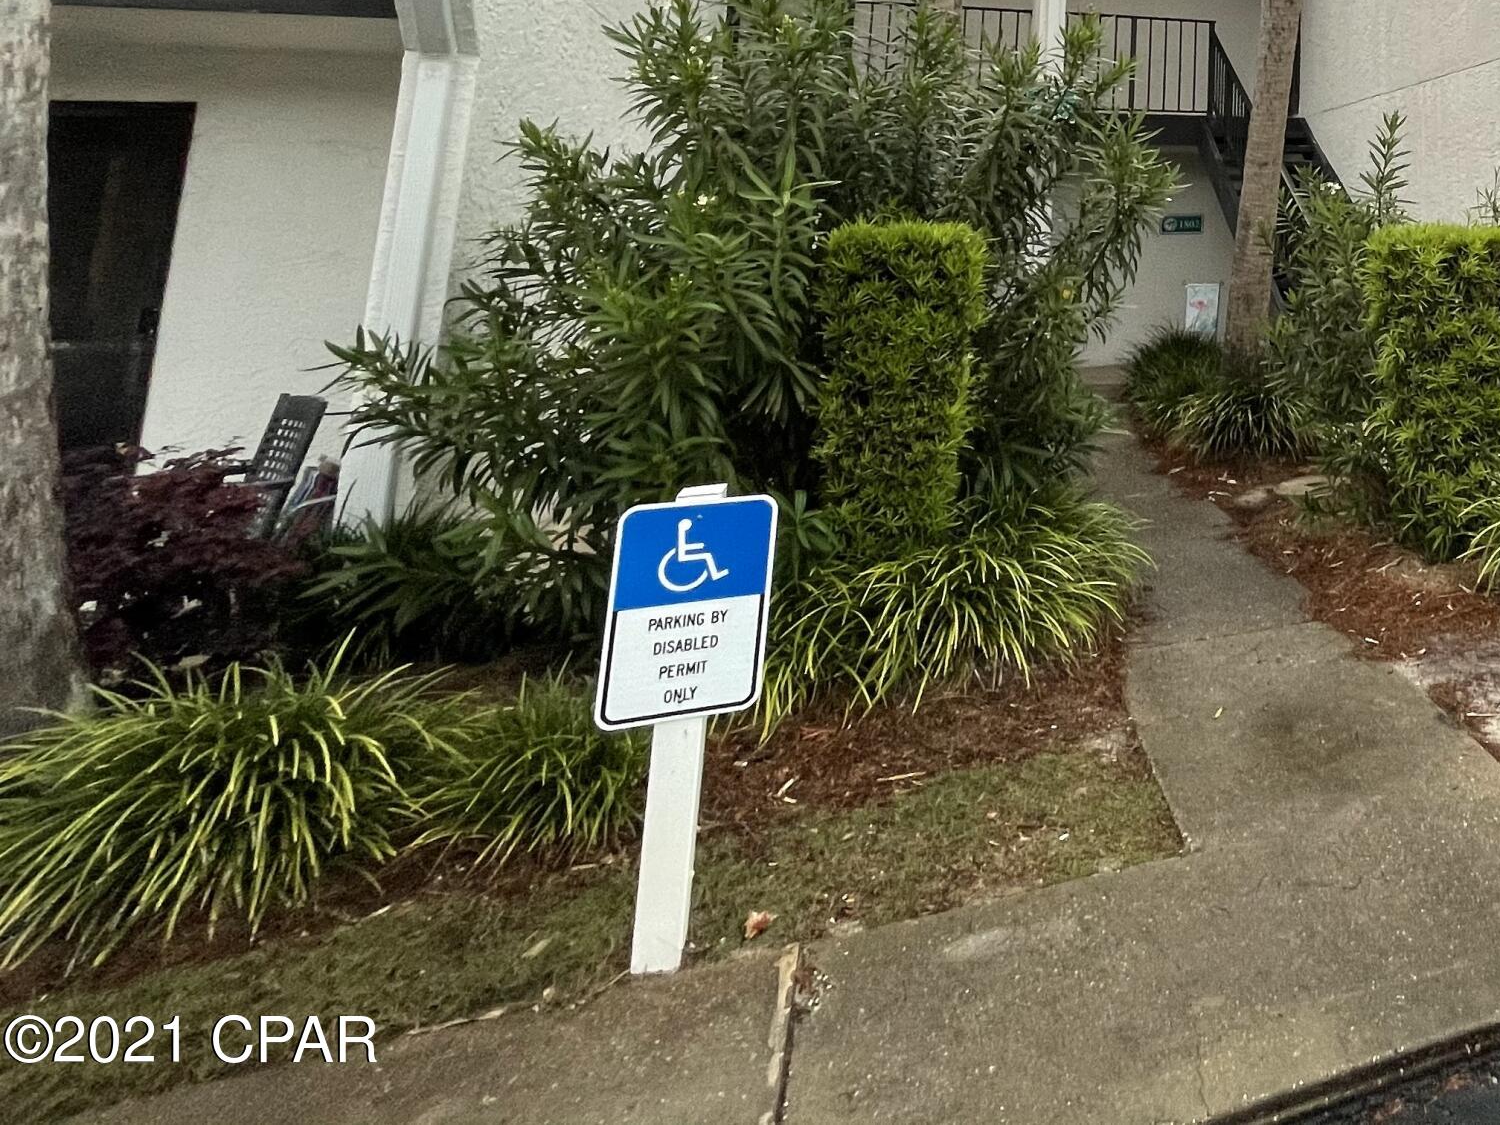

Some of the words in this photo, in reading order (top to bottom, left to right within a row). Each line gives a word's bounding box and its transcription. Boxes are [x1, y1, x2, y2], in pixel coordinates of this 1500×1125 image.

[648, 612, 705, 631] PARKING
[711, 609, 728, 624] BY
[653, 635, 718, 655] DISABLED
[658, 660, 707, 679] PERMIT
[663, 686, 697, 704] ONLY
